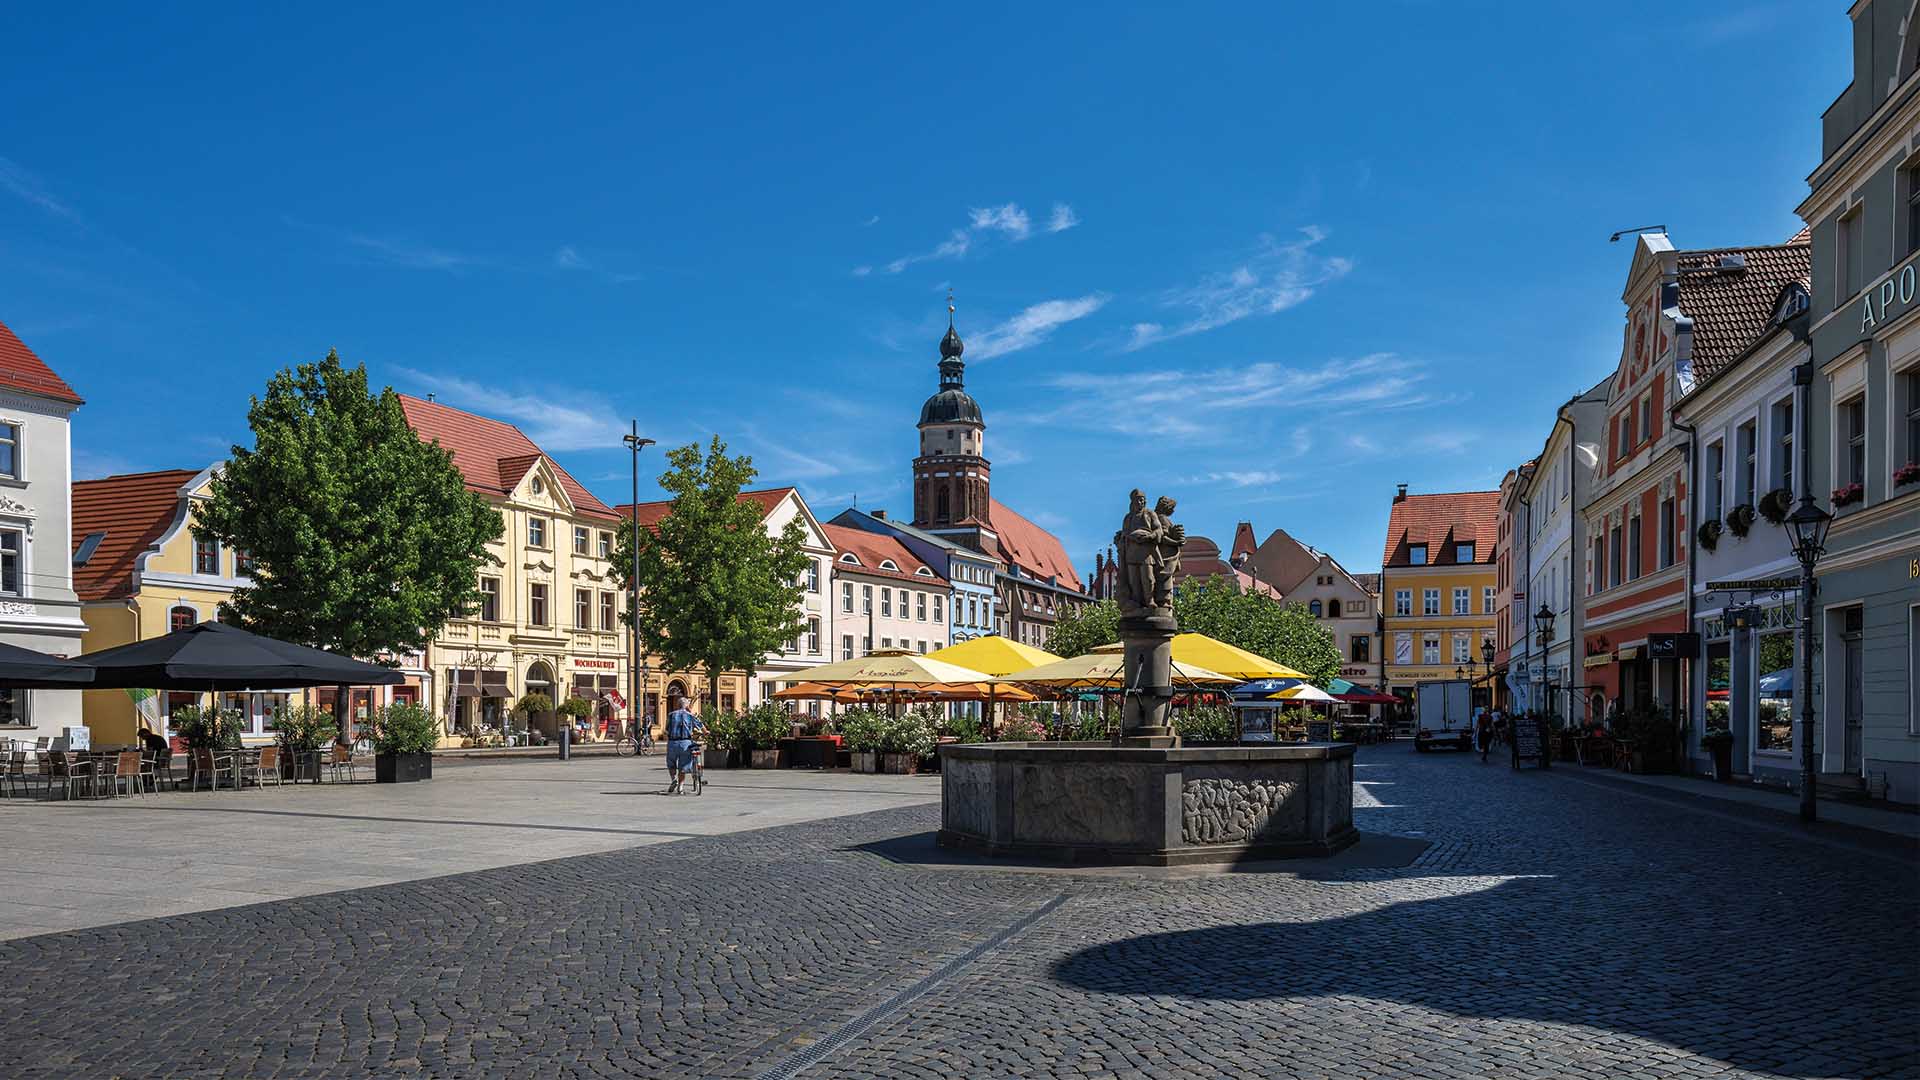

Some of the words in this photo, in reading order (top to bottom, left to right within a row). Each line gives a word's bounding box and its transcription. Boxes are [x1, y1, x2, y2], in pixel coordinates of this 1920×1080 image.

[1860, 264, 1916, 334] APO
[575, 659, 615, 669] WOCHENKURIER
[1338, 667, 1367, 676] istro
